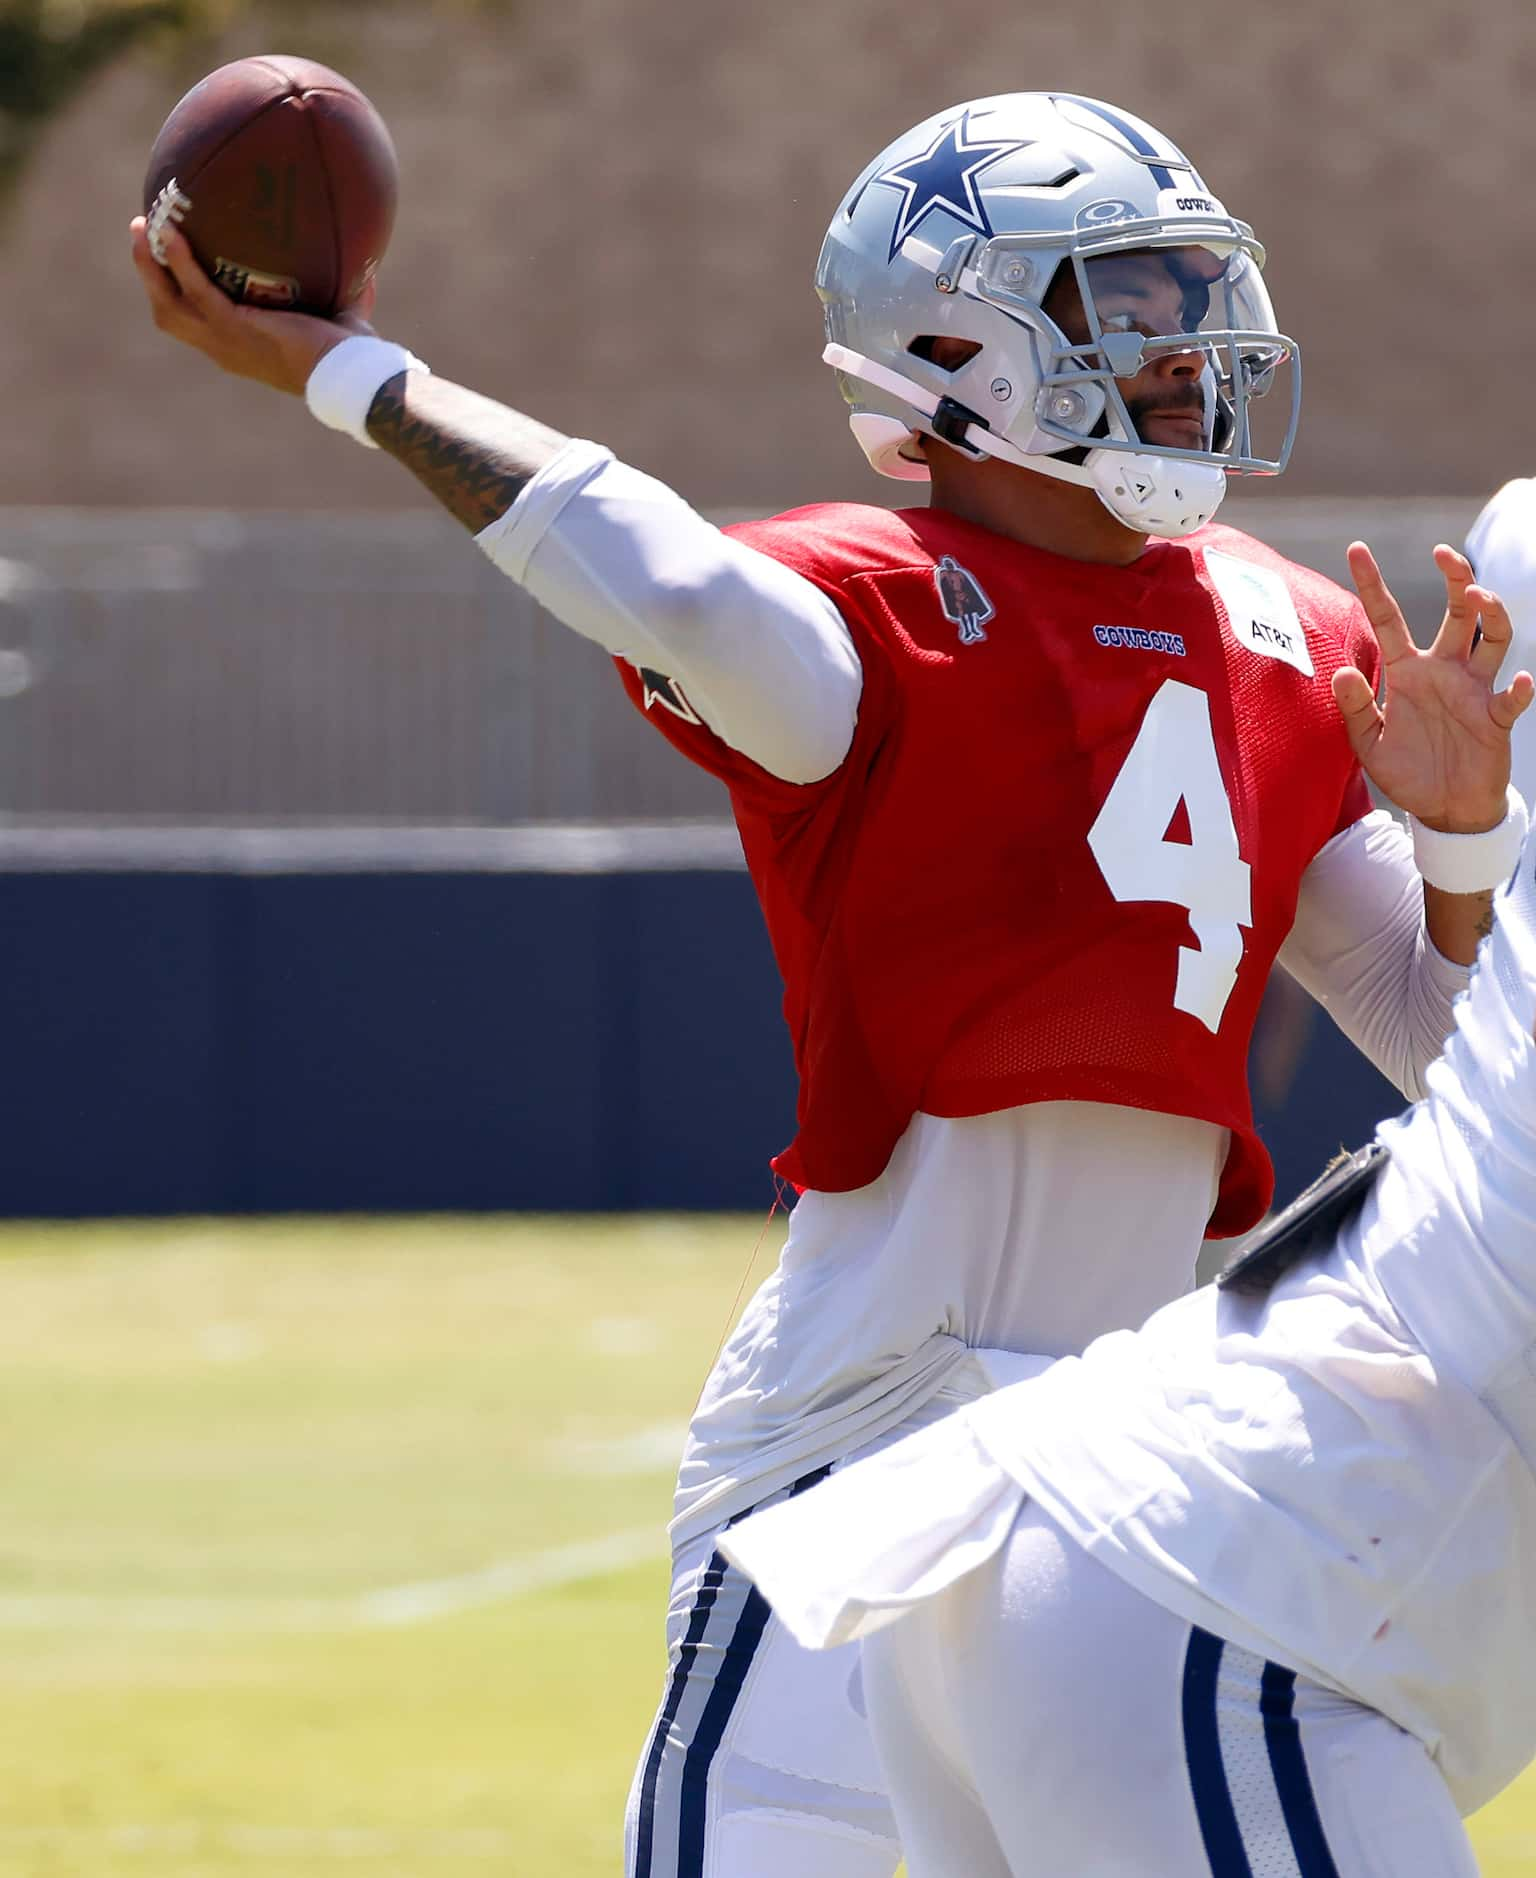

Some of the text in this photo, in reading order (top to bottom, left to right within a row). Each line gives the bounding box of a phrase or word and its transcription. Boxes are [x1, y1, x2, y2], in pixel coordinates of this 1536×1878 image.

[1093, 624, 1186, 656] COWBOYS
[1252, 618, 1295, 655] AT&T
[1086, 677, 1254, 1036] 4
